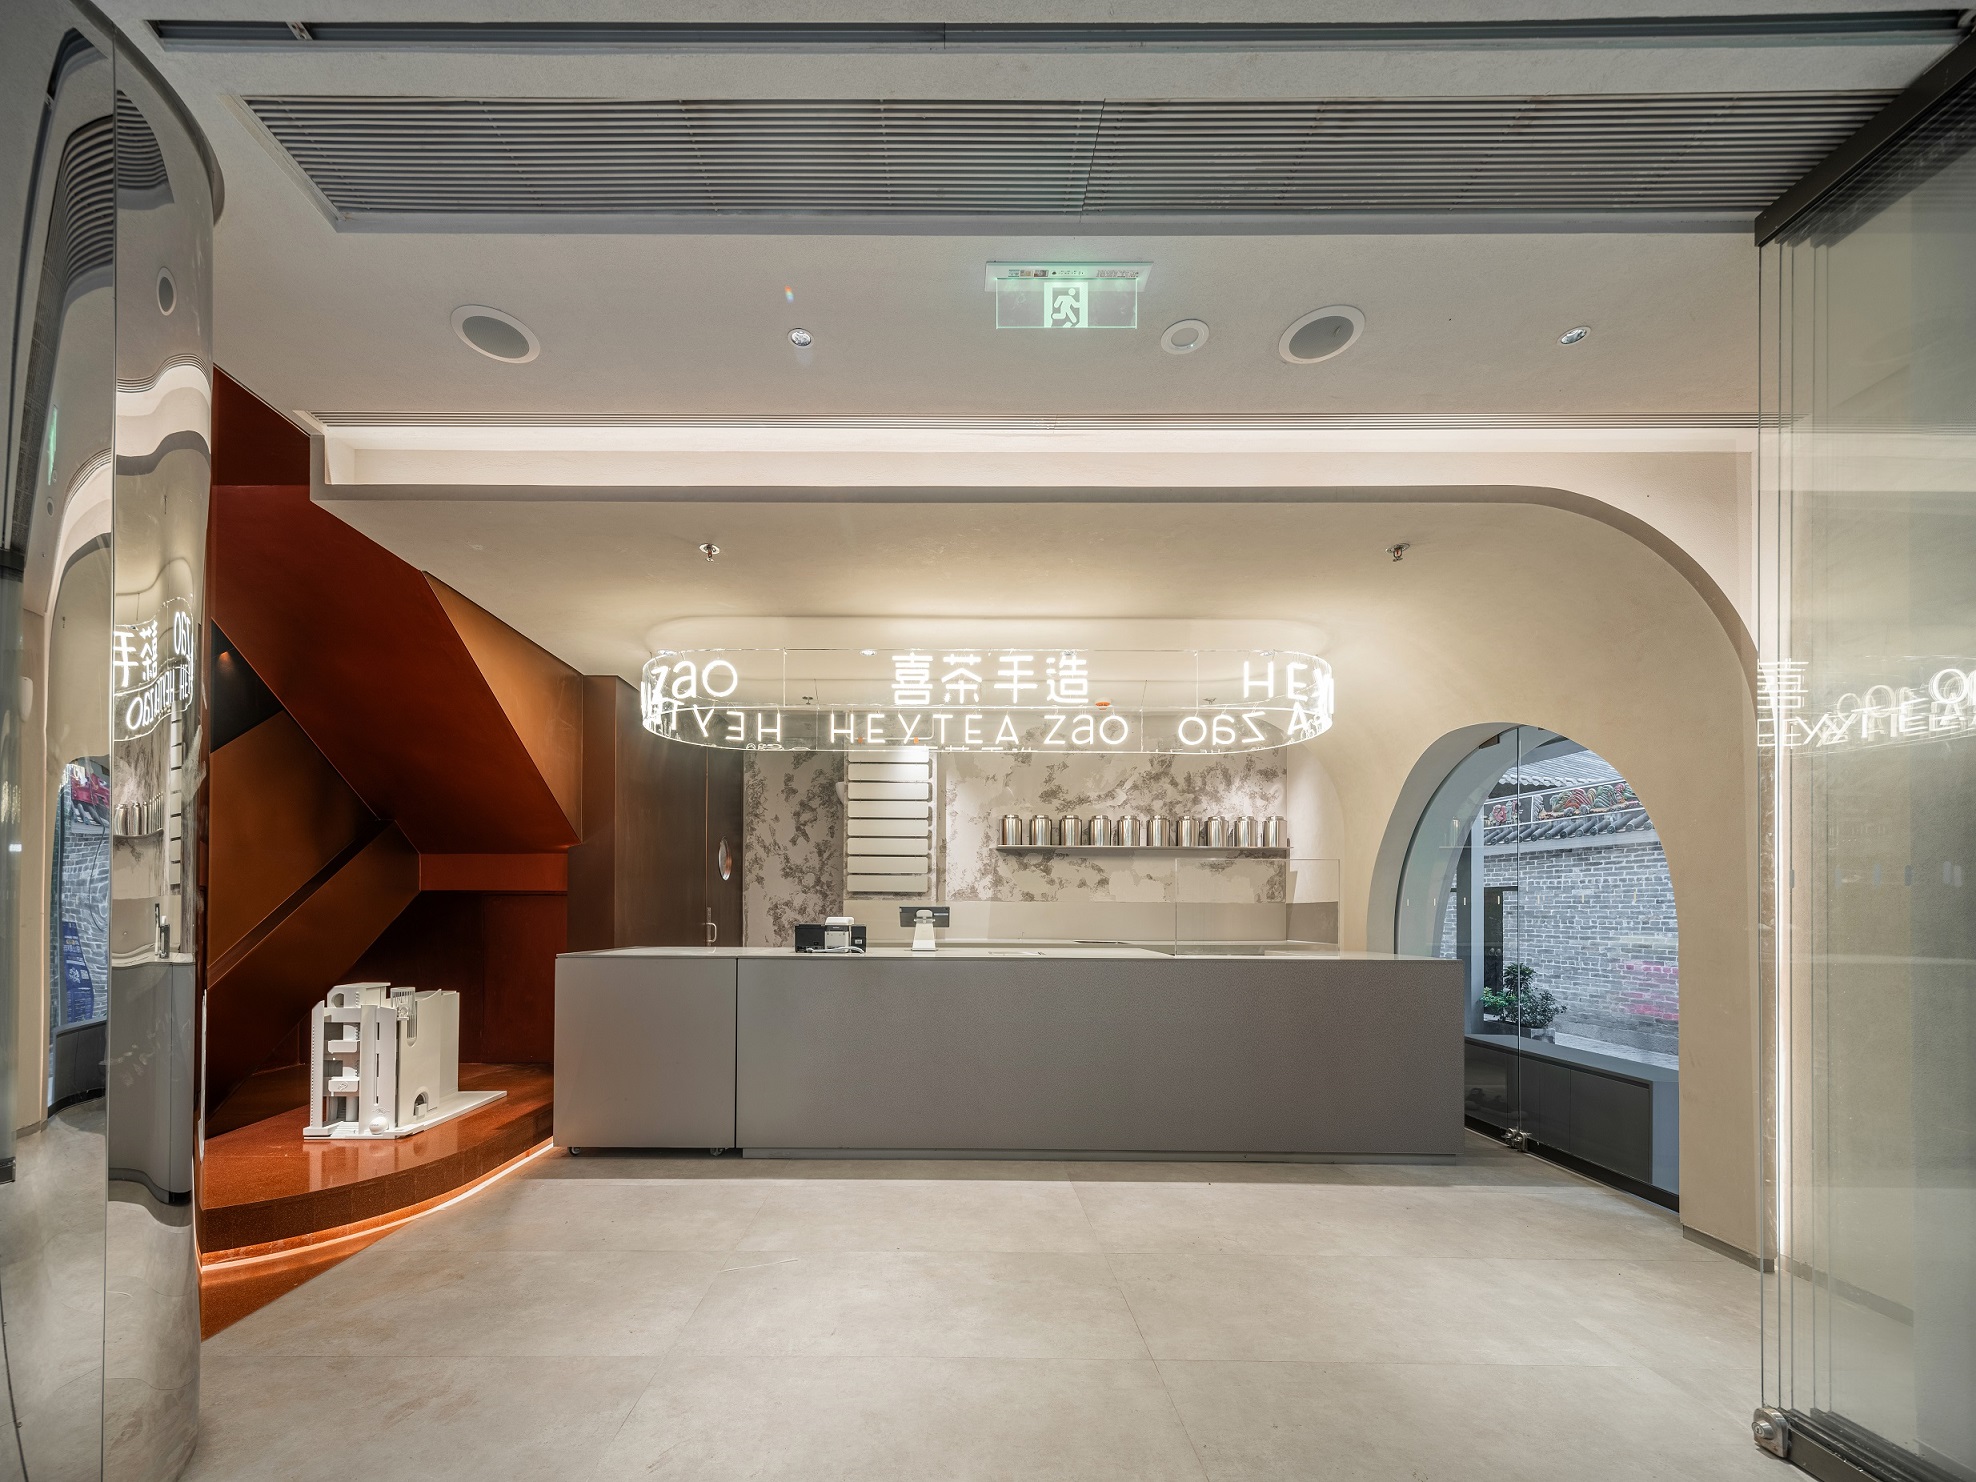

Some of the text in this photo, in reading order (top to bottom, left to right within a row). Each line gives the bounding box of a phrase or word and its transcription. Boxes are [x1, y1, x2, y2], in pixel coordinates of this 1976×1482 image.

[892, 652, 1090, 705] 喜茶手造
[830, 713, 1020, 744] HEYTEA
